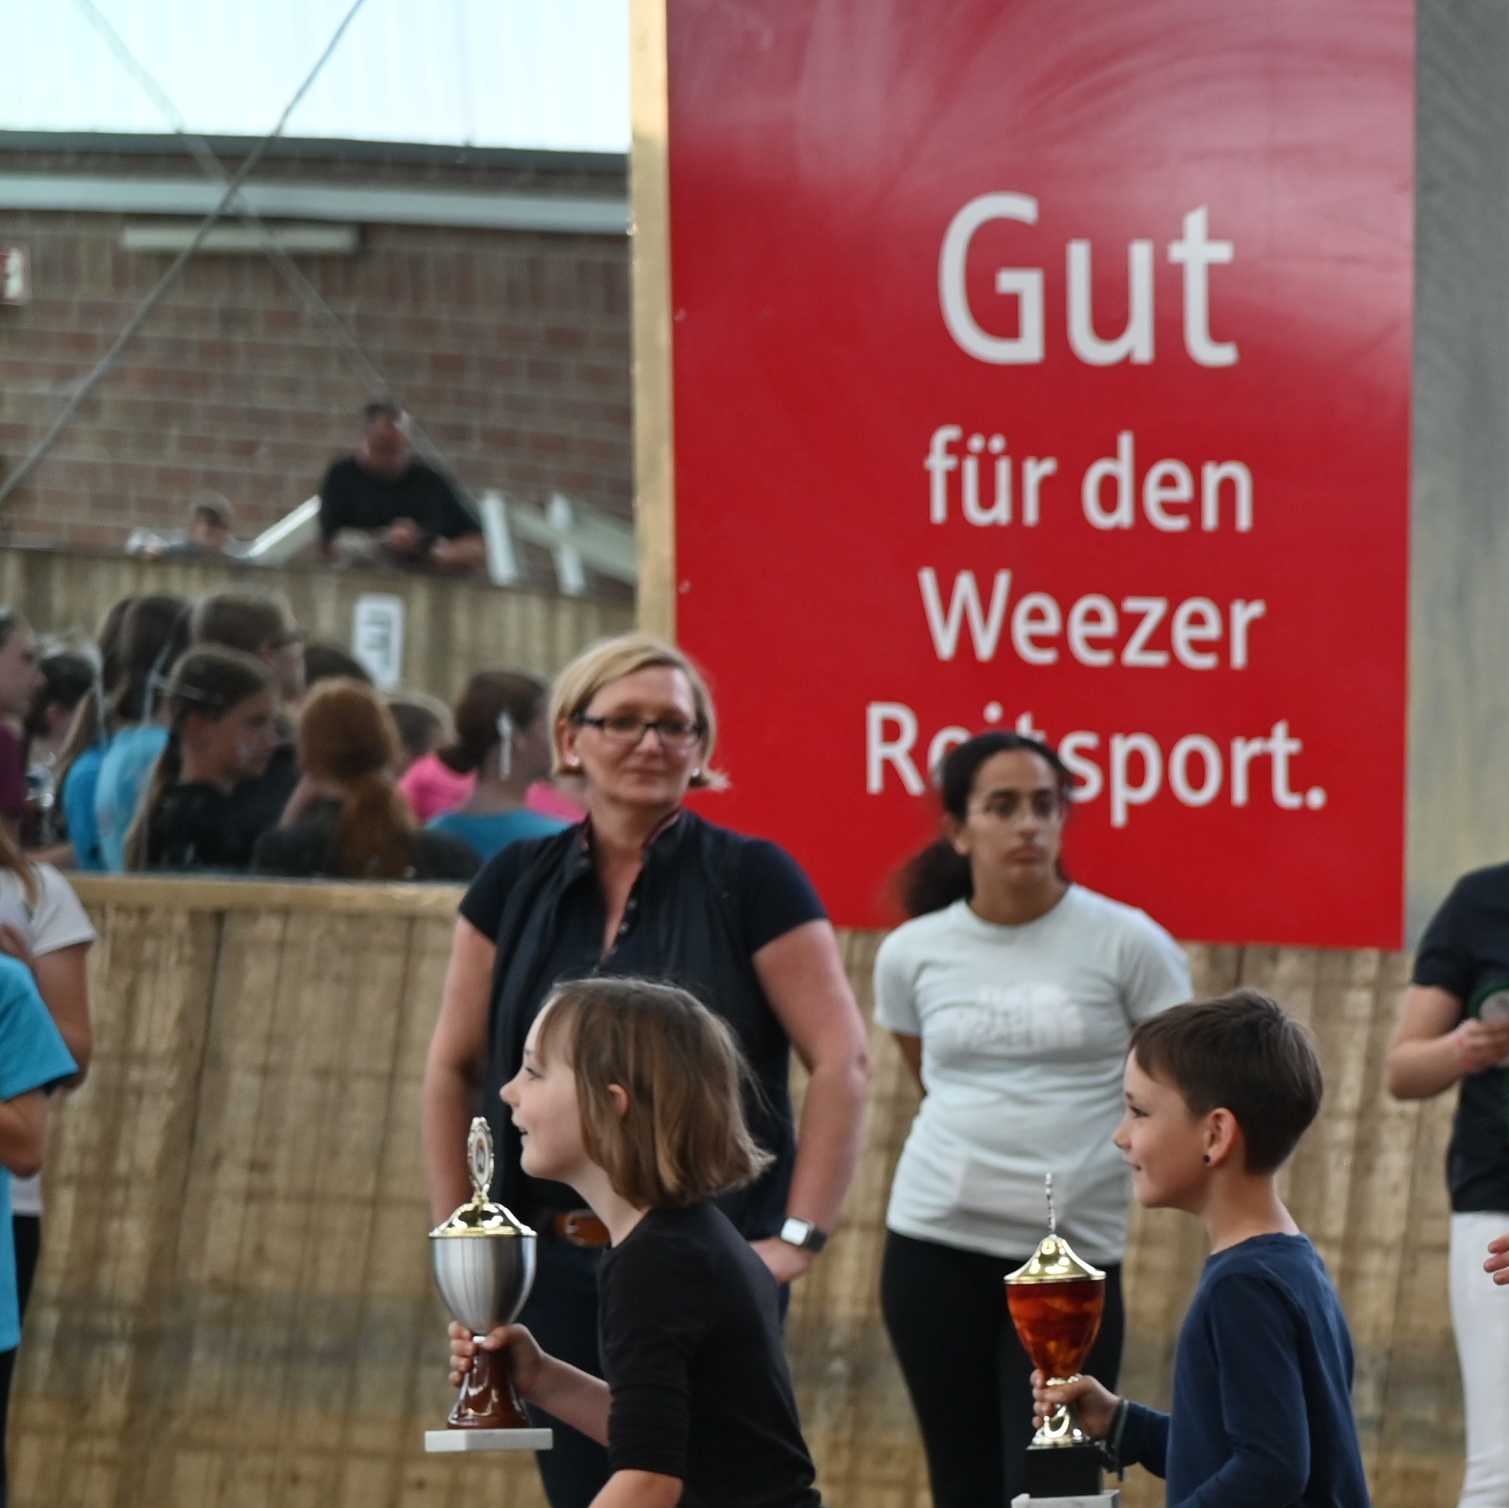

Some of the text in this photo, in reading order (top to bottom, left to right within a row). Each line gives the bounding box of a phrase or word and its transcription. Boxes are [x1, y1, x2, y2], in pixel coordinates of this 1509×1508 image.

[938, 191, 1239, 368] Gut
[924, 425, 1254, 532] für den
[918, 568, 1267, 670] Weezer
